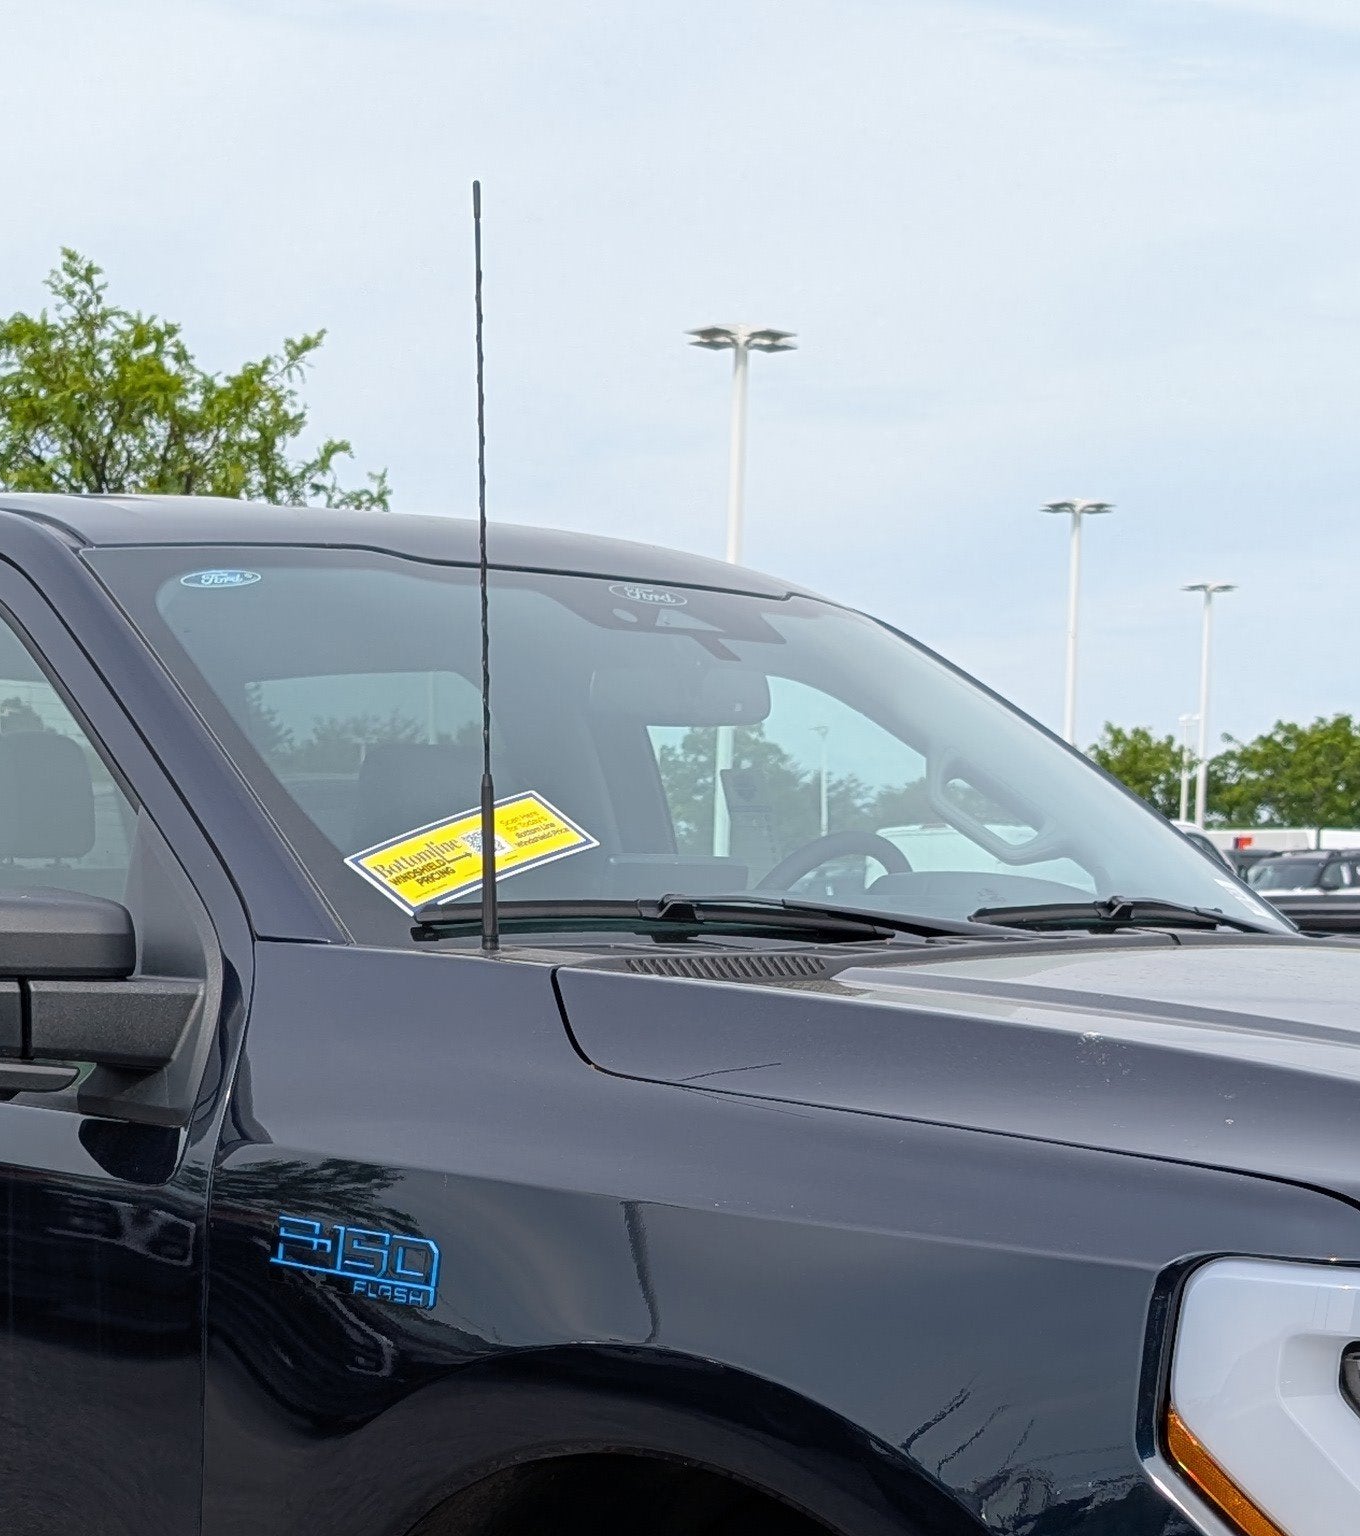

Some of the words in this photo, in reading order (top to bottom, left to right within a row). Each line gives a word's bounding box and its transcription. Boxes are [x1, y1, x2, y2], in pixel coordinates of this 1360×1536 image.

[623, 583, 676, 604] Ford
[371, 840, 462, 879] Bottomline
[388, 859, 446, 886] WINDSHIELD
[415, 866, 456, 887] PRICING
[352, 1280, 424, 1306] FLASH
